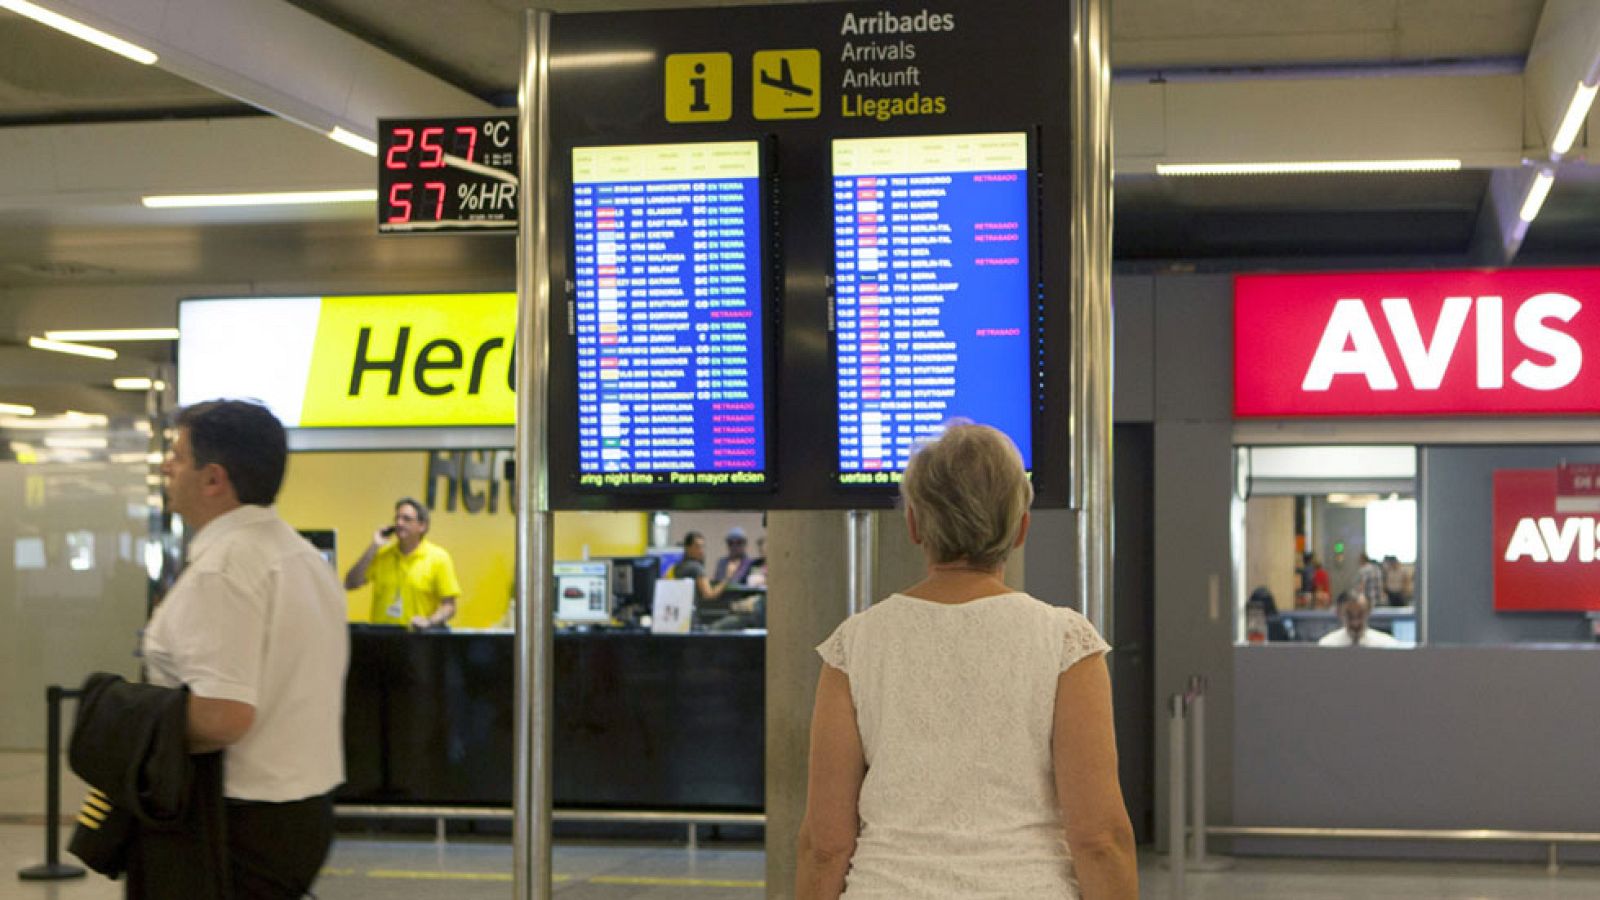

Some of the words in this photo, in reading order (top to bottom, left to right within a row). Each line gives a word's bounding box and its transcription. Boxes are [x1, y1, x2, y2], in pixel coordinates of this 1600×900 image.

[841, 10, 955, 35] Arribades
[841, 40, 915, 62] Arrivals
[841, 66, 921, 88] Ankunft
[842, 92, 947, 121] Llegadas
[973, 174, 1017, 182] RETRASADO
[387, 182, 447, 224] 57
[458, 182, 515, 210] %HR
[974, 222, 1018, 230] RETRASADO
[974, 234, 1018, 242] RETRASADO
[975, 258, 1018, 266] RETRASADO
[976, 328, 1019, 337] RETRASADO
[1301, 293, 1583, 391] AVIS
[605, 473, 629, 486] night
[631, 473, 654, 484] time
[671, 472, 695, 484] Para
[696, 473, 729, 486] mayor
[731, 472, 765, 484] eficien
[875, 472, 888, 484] de
[1504, 517, 1600, 563] AVI
